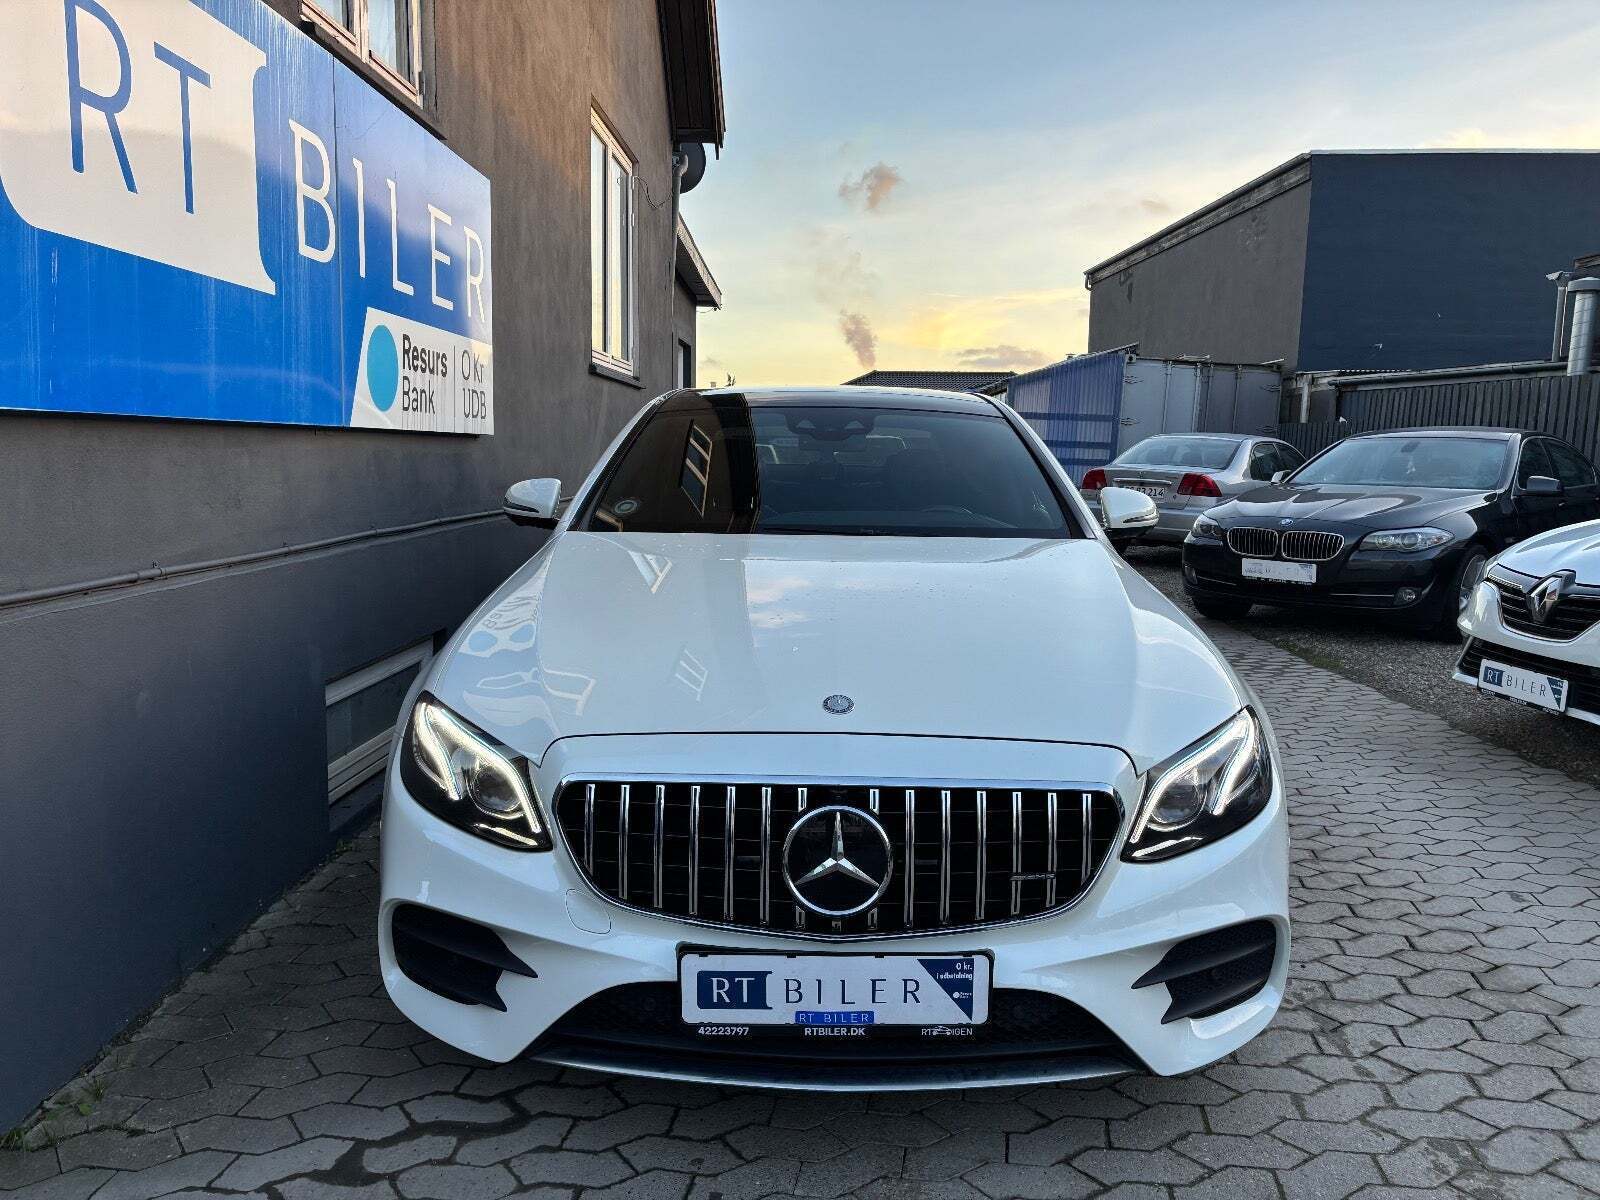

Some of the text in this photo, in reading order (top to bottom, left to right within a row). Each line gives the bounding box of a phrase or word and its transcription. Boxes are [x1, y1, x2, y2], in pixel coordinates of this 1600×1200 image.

[64, 0, 485, 323] RT BILER
[402, 333, 448, 378] Resurs
[402, 375, 436, 415] Bank
[462, 387, 487, 419] UDB
[1487, 669, 1499, 683] RT
[1506, 674, 1547, 697] BILER
[710, 977, 920, 1004] RT BILER
[698, 1026, 750, 1036] 42223797
[799, 1013, 869, 1023] RT BILER
[804, 1027, 866, 1036] RTBILER.DK
